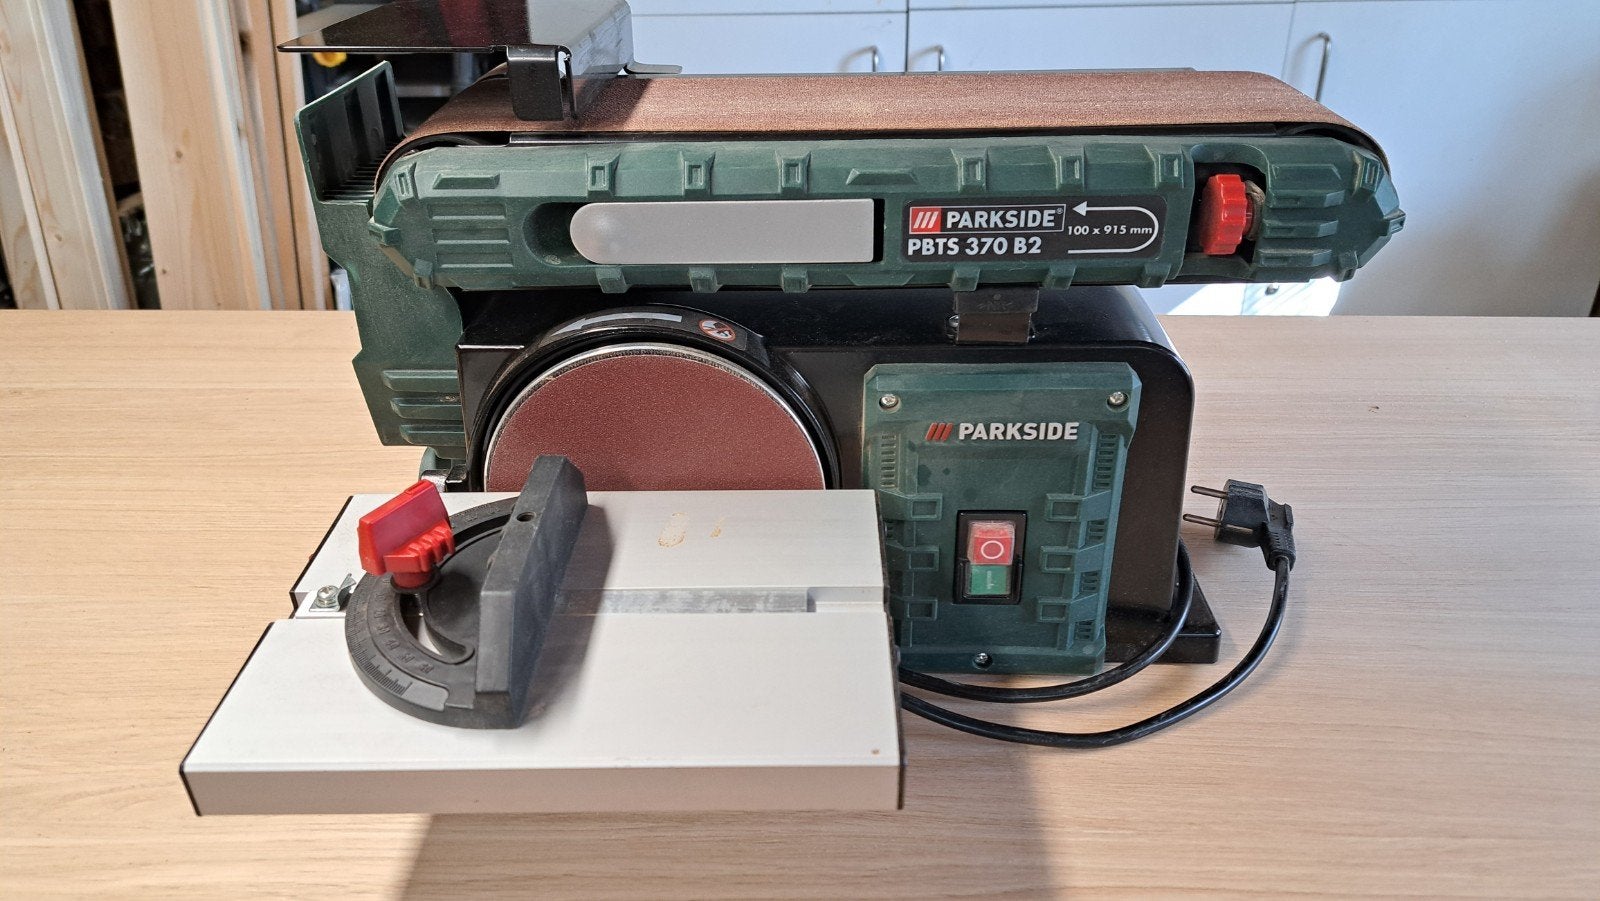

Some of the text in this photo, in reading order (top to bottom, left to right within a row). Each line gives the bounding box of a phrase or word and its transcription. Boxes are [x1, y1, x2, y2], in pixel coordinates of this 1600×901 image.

[1067, 225, 1090, 236] 100
[1103, 225, 1127, 235] 915
[1129, 227, 1153, 235] mm
[907, 236, 1042, 256] PBTS 370 B2
[958, 421, 1080, 441] PARKSIDE
